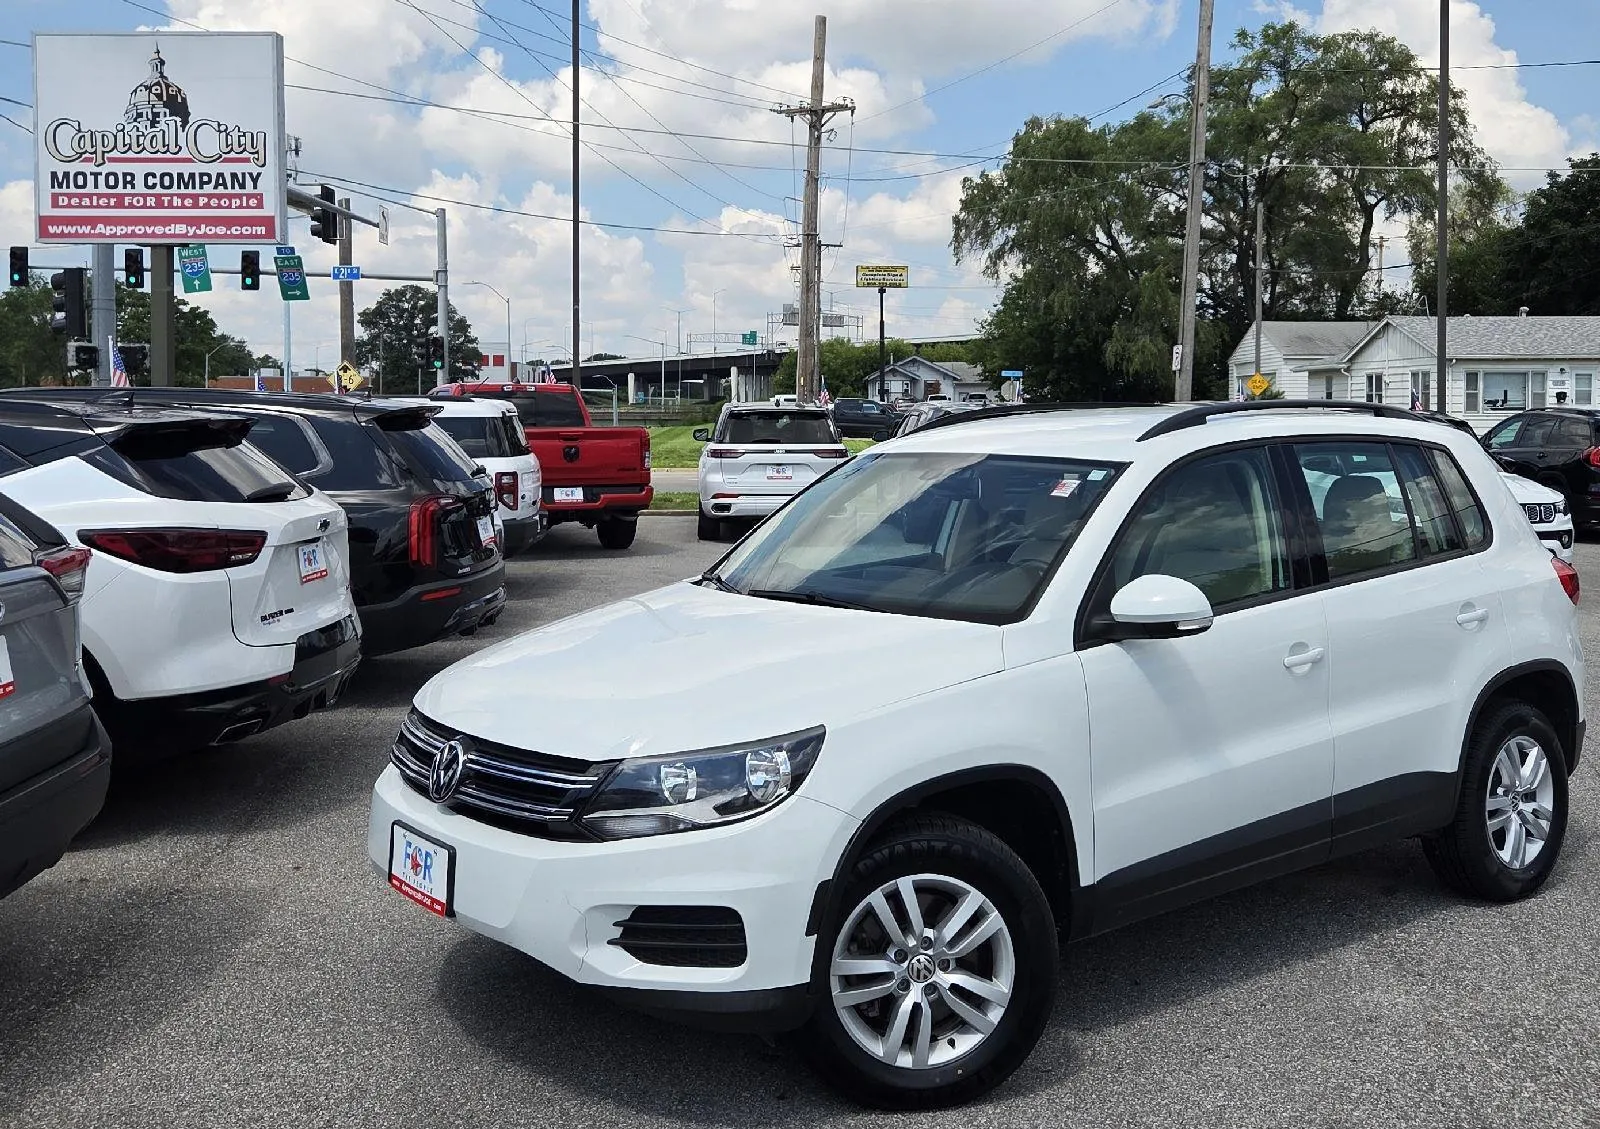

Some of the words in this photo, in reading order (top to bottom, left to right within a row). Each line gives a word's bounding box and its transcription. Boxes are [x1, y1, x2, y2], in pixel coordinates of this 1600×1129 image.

[44, 117, 182, 167] Capital
[186, 118, 267, 168] City
[50, 171, 136, 190] MOTOR
[143, 171, 263, 191] COMPANY
[58, 195, 117, 207] Dealer
[124, 196, 156, 207] FOR
[161, 196, 193, 207] The
[47, 223, 266, 236] www.ApprovedByJoe.com
[180, 248, 204, 257] WEST
[185, 261, 205, 273] 235
[277, 258, 299, 266] EAST
[281, 272, 301, 281] 235
[404, 839, 434, 885] FOR
